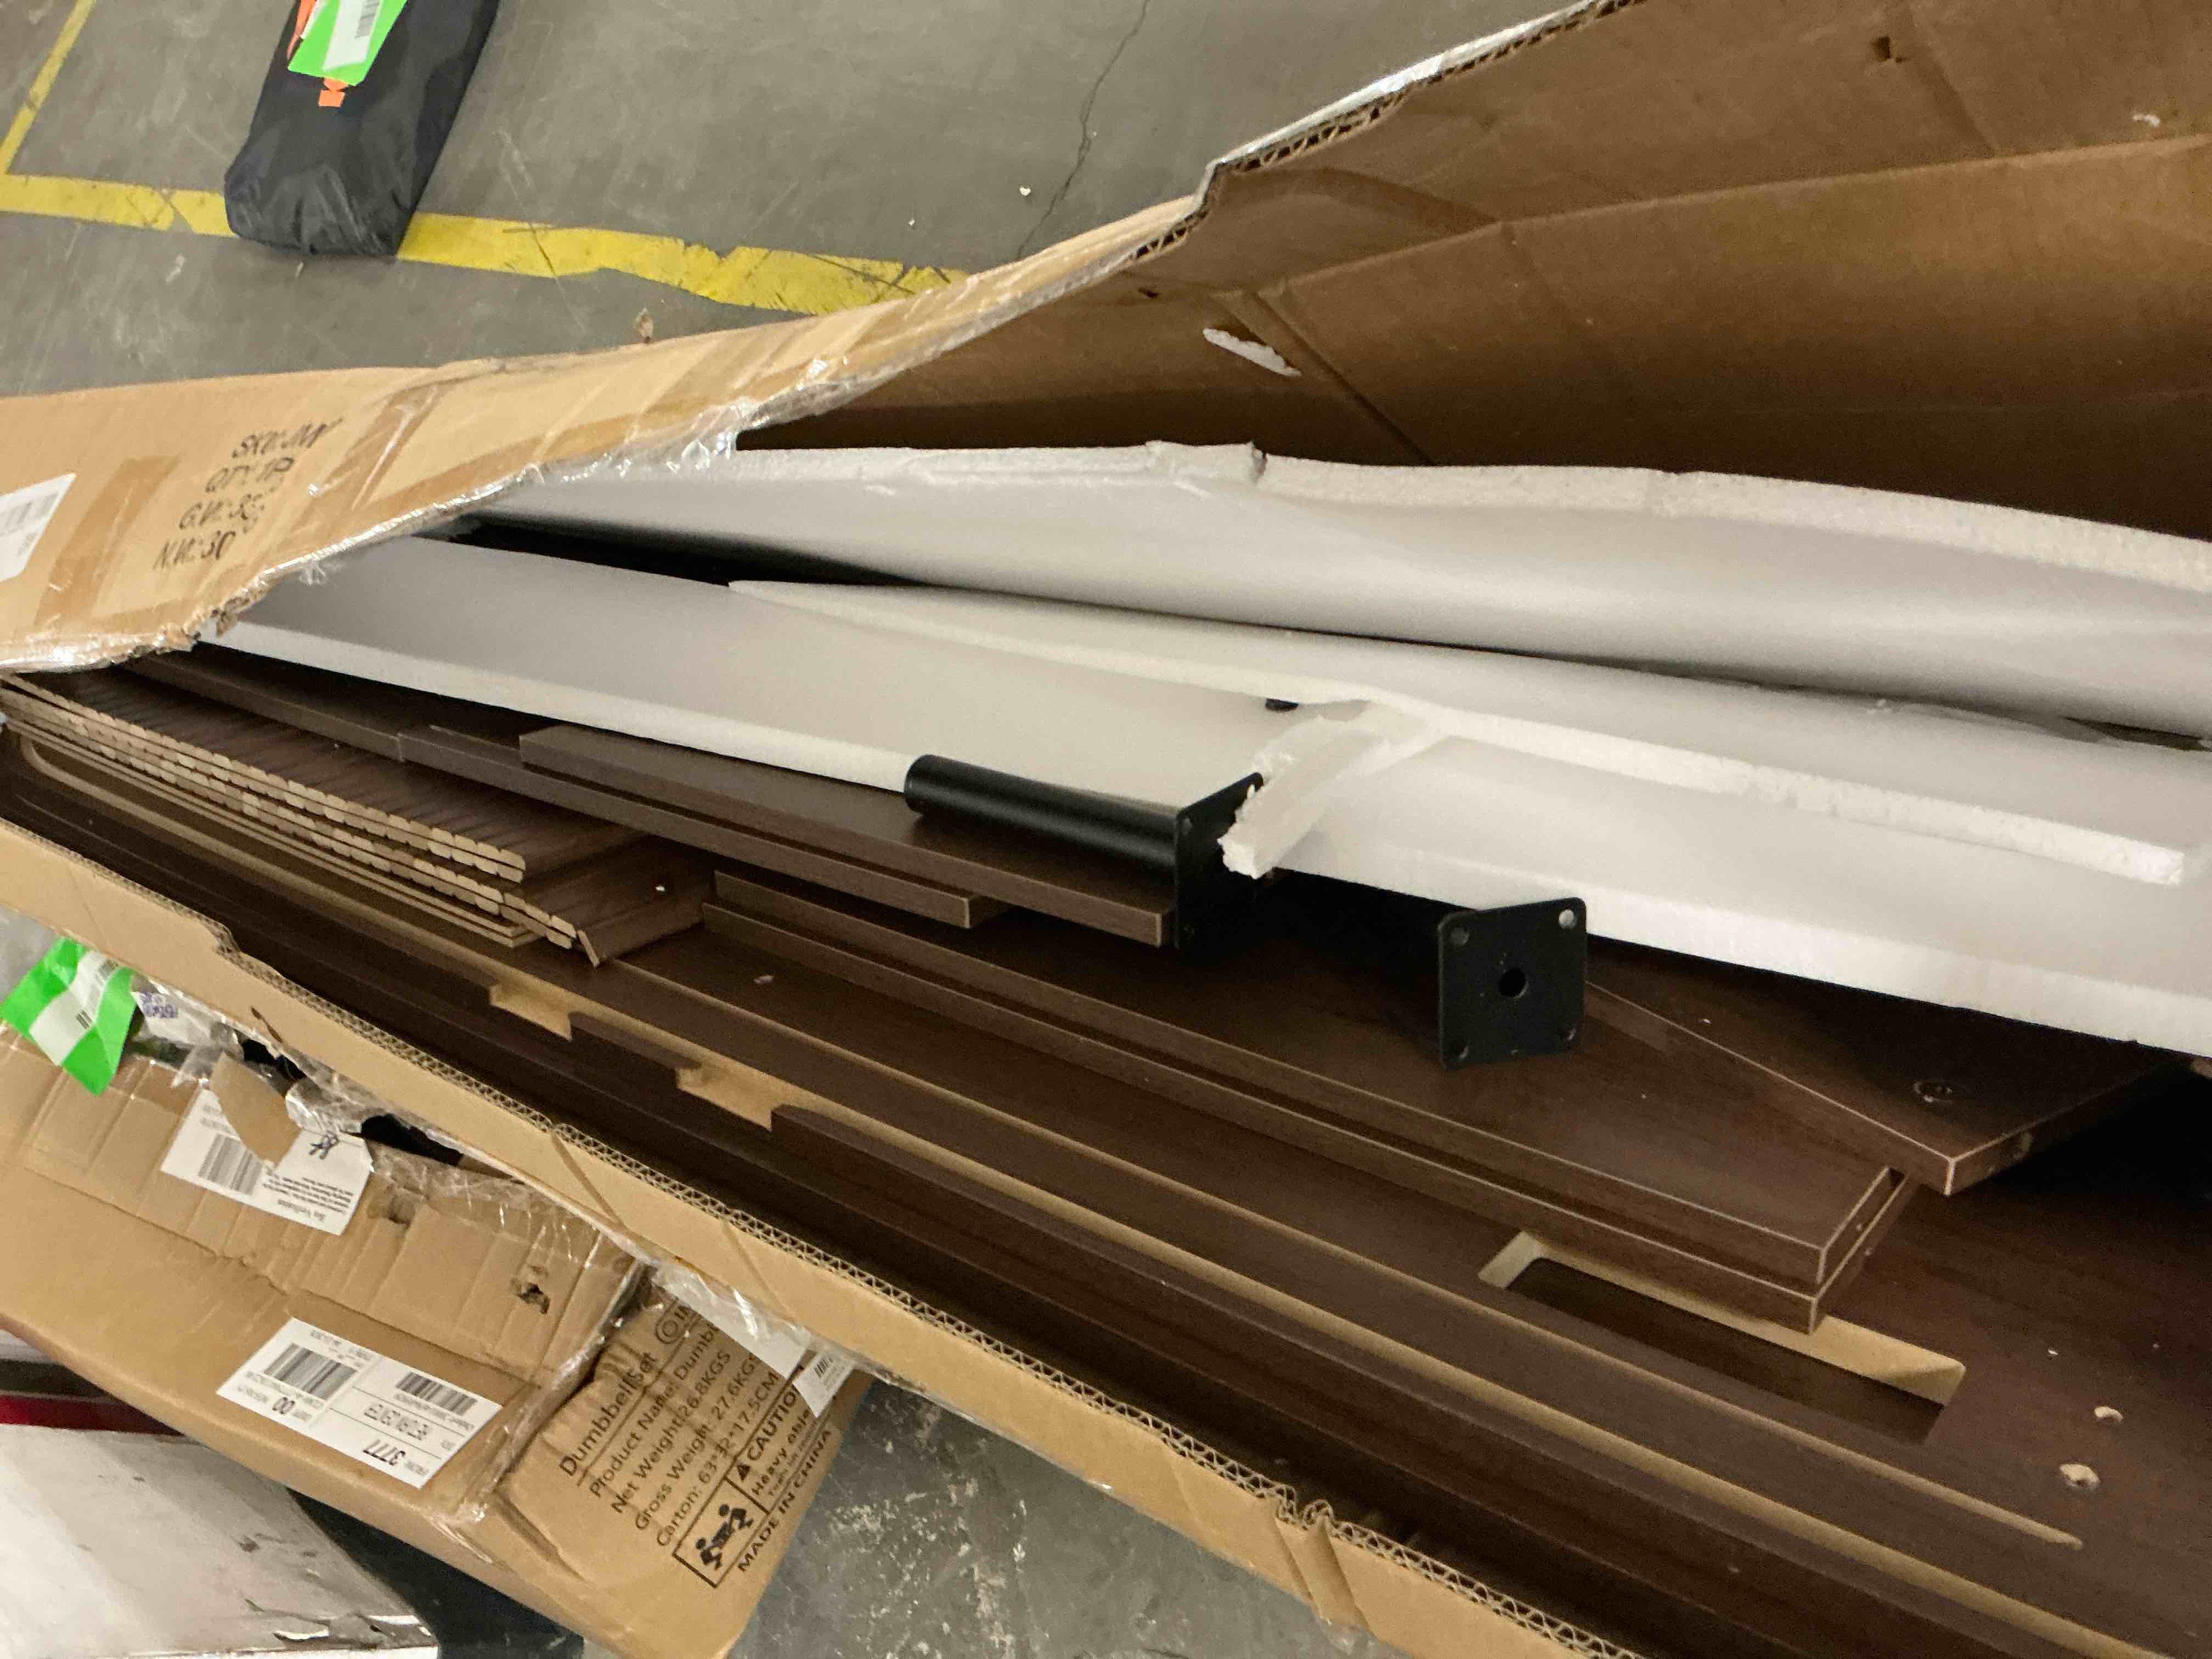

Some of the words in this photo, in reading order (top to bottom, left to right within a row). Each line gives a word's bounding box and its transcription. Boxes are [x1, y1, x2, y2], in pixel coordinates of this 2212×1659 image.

[363, 1439, 406, 1466] 3777
[589, 1432, 642, 1498] Product
[610, 1481, 640, 1514] Net
[635, 1483, 672, 1531] Gross
[737, 1517, 779, 1573] MADE
[778, 1492, 795, 1514] IN
[794, 1431, 831, 1488] CHINA
